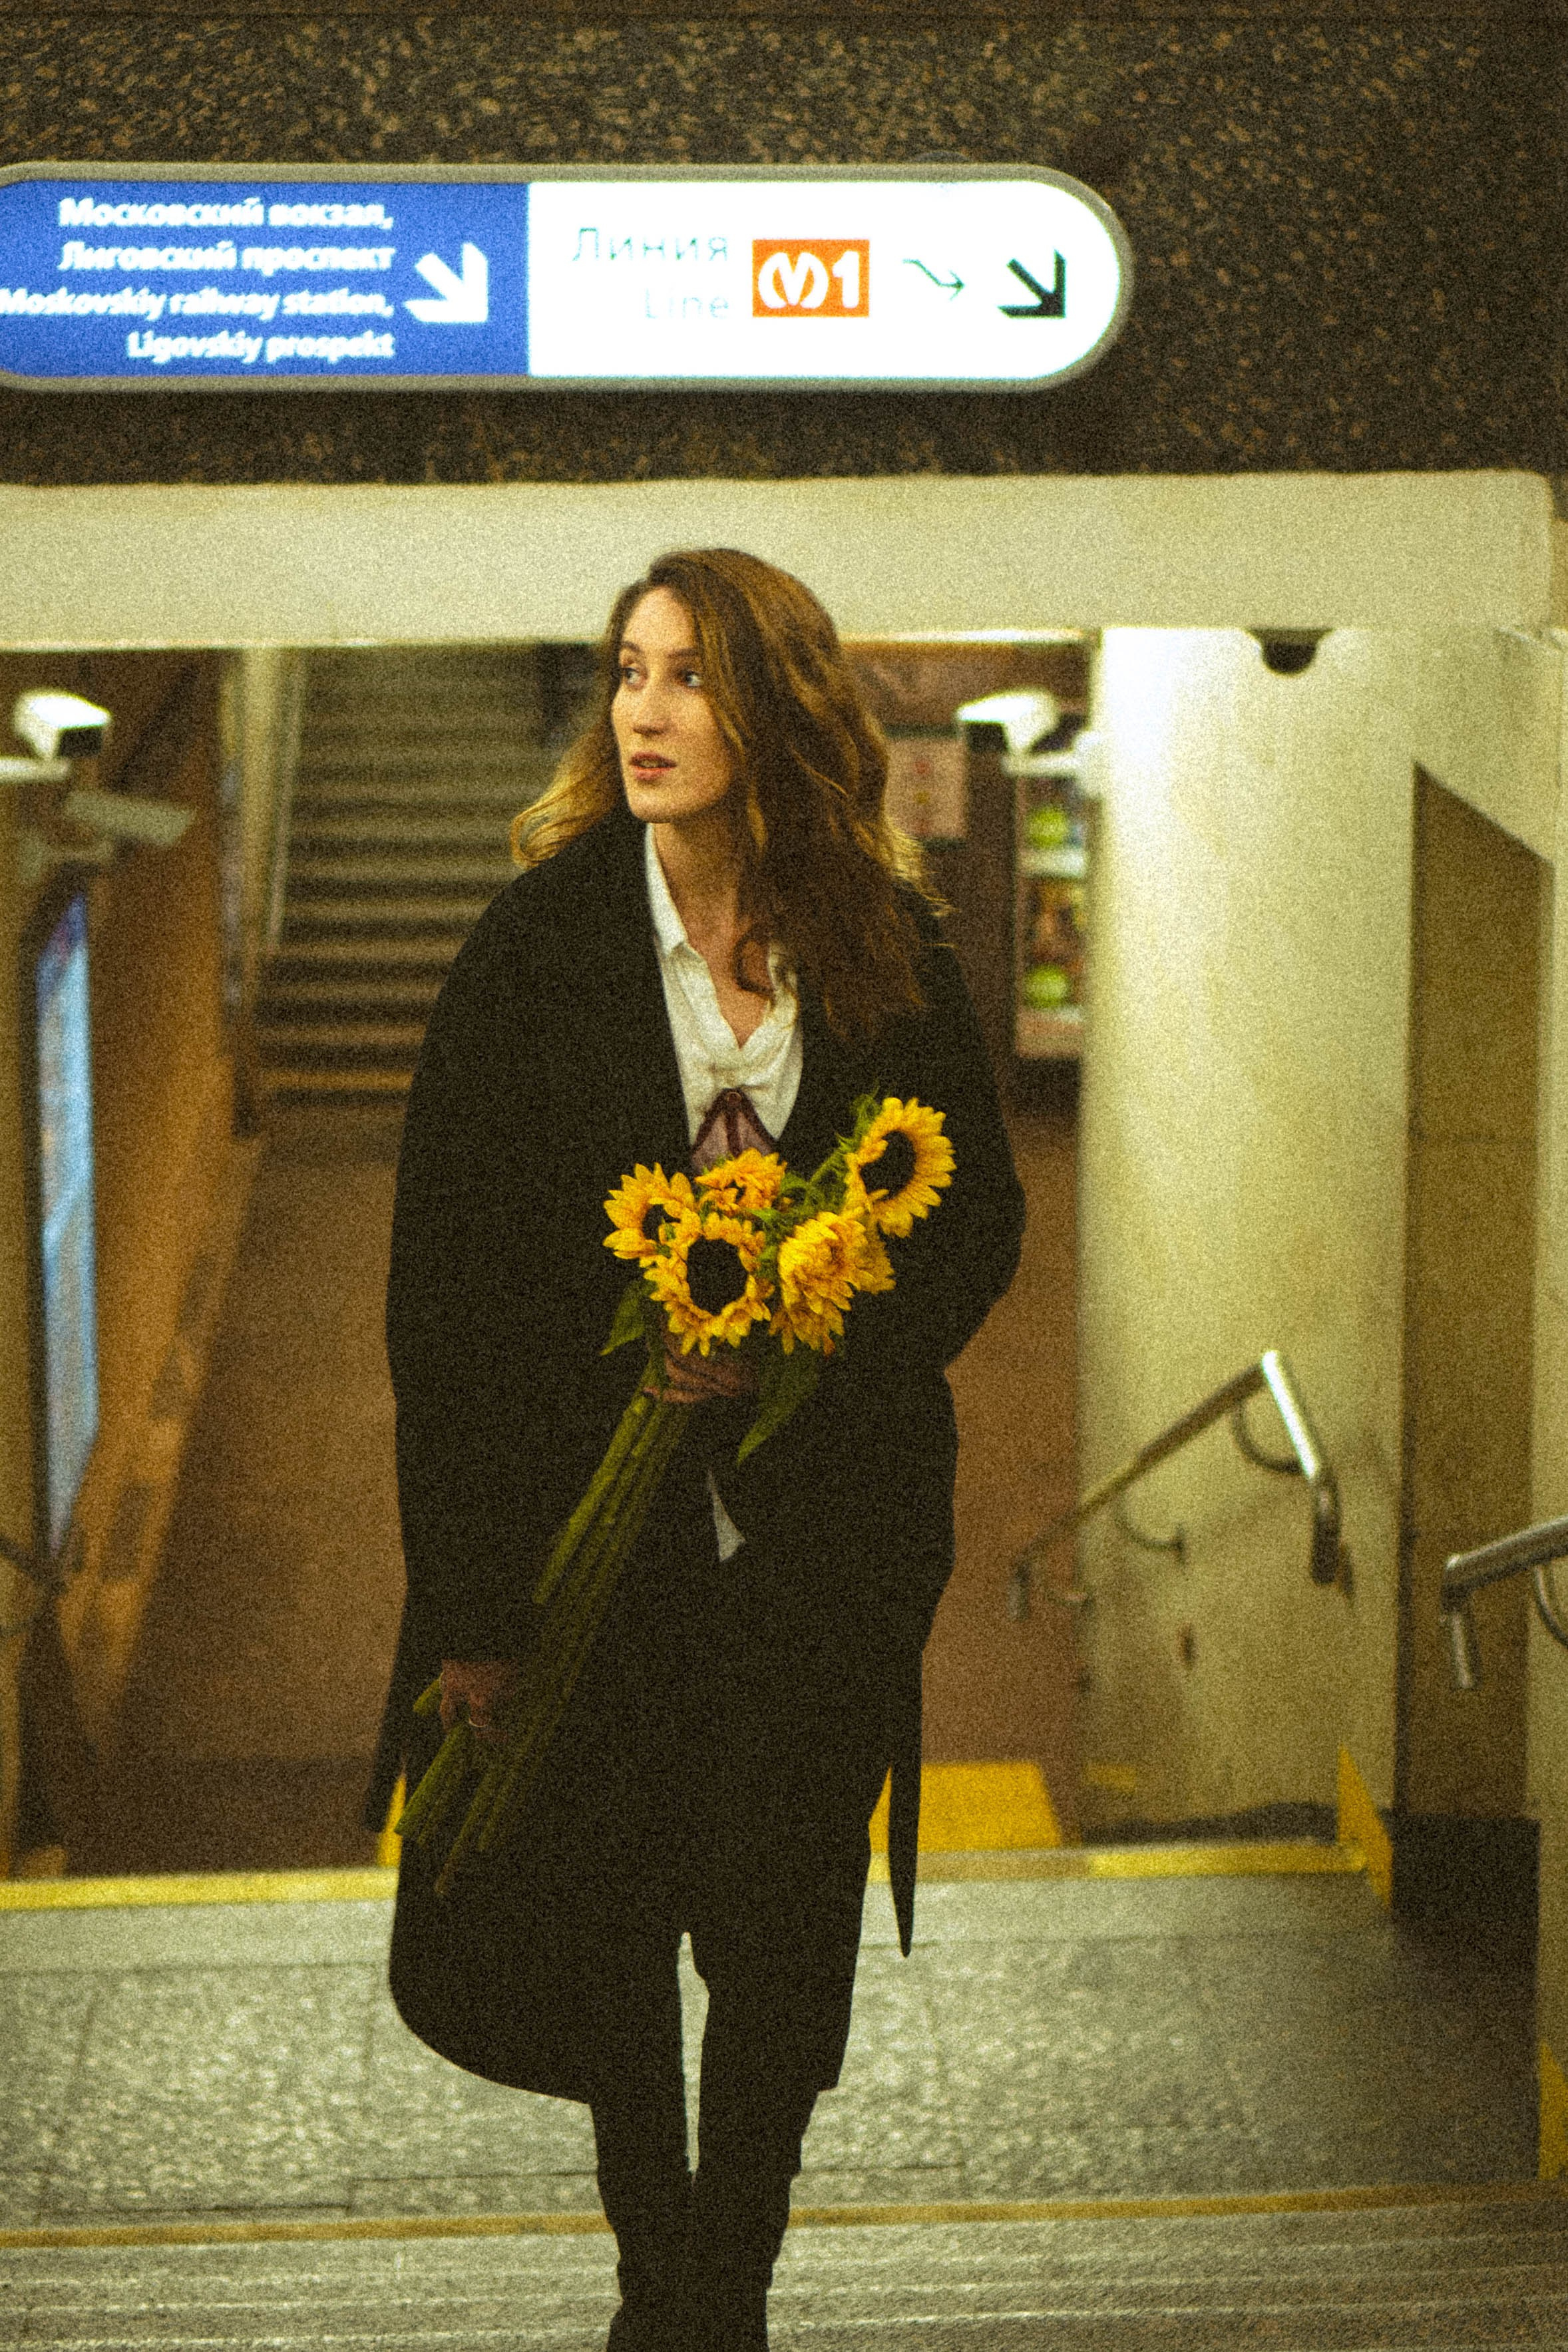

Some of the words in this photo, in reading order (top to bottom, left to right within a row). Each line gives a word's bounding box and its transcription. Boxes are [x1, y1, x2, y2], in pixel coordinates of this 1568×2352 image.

[59, 197, 264, 227] Московский
[268, 203, 394, 230] вокзал,
[59, 240, 238, 270] Лиговский
[242, 247, 395, 276] проспект
[572, 227, 728, 261] Линия
[0, 287, 166, 321] Moskovskiy
[169, 287, 280, 321] railway
[282, 288, 395, 317] station,
[644, 289, 729, 319] Line
[126, 330, 264, 363] Ligovskiy
[266, 330, 395, 363] prospekt
